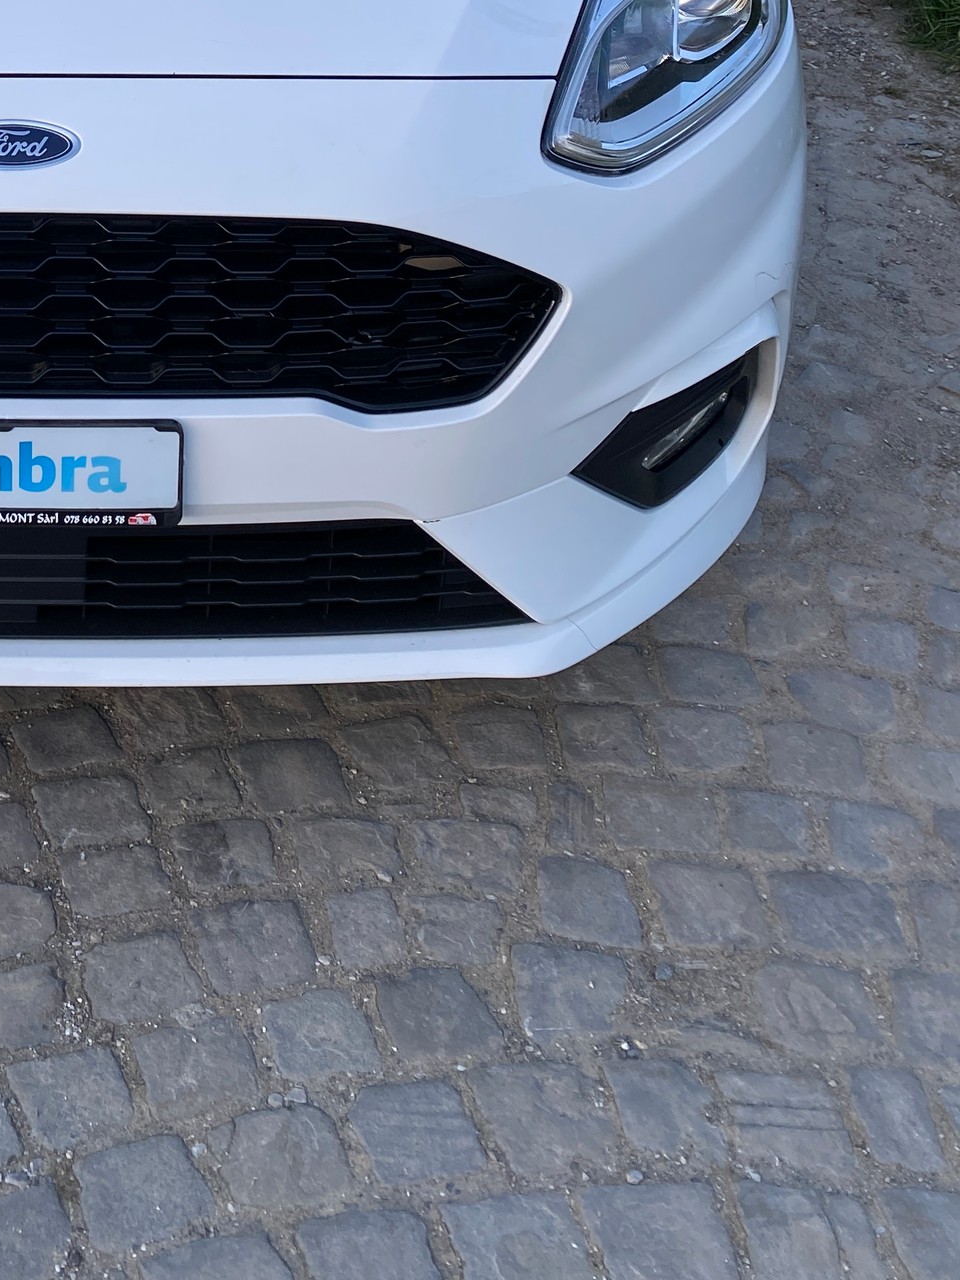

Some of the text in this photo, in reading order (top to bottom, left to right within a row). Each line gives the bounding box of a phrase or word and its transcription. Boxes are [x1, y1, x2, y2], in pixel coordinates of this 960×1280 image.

[64, 515, 80, 524] 078
[82, 515, 100, 524] 660
[102, 515, 112, 524] 83
[114, 515, 126, 524] 58
